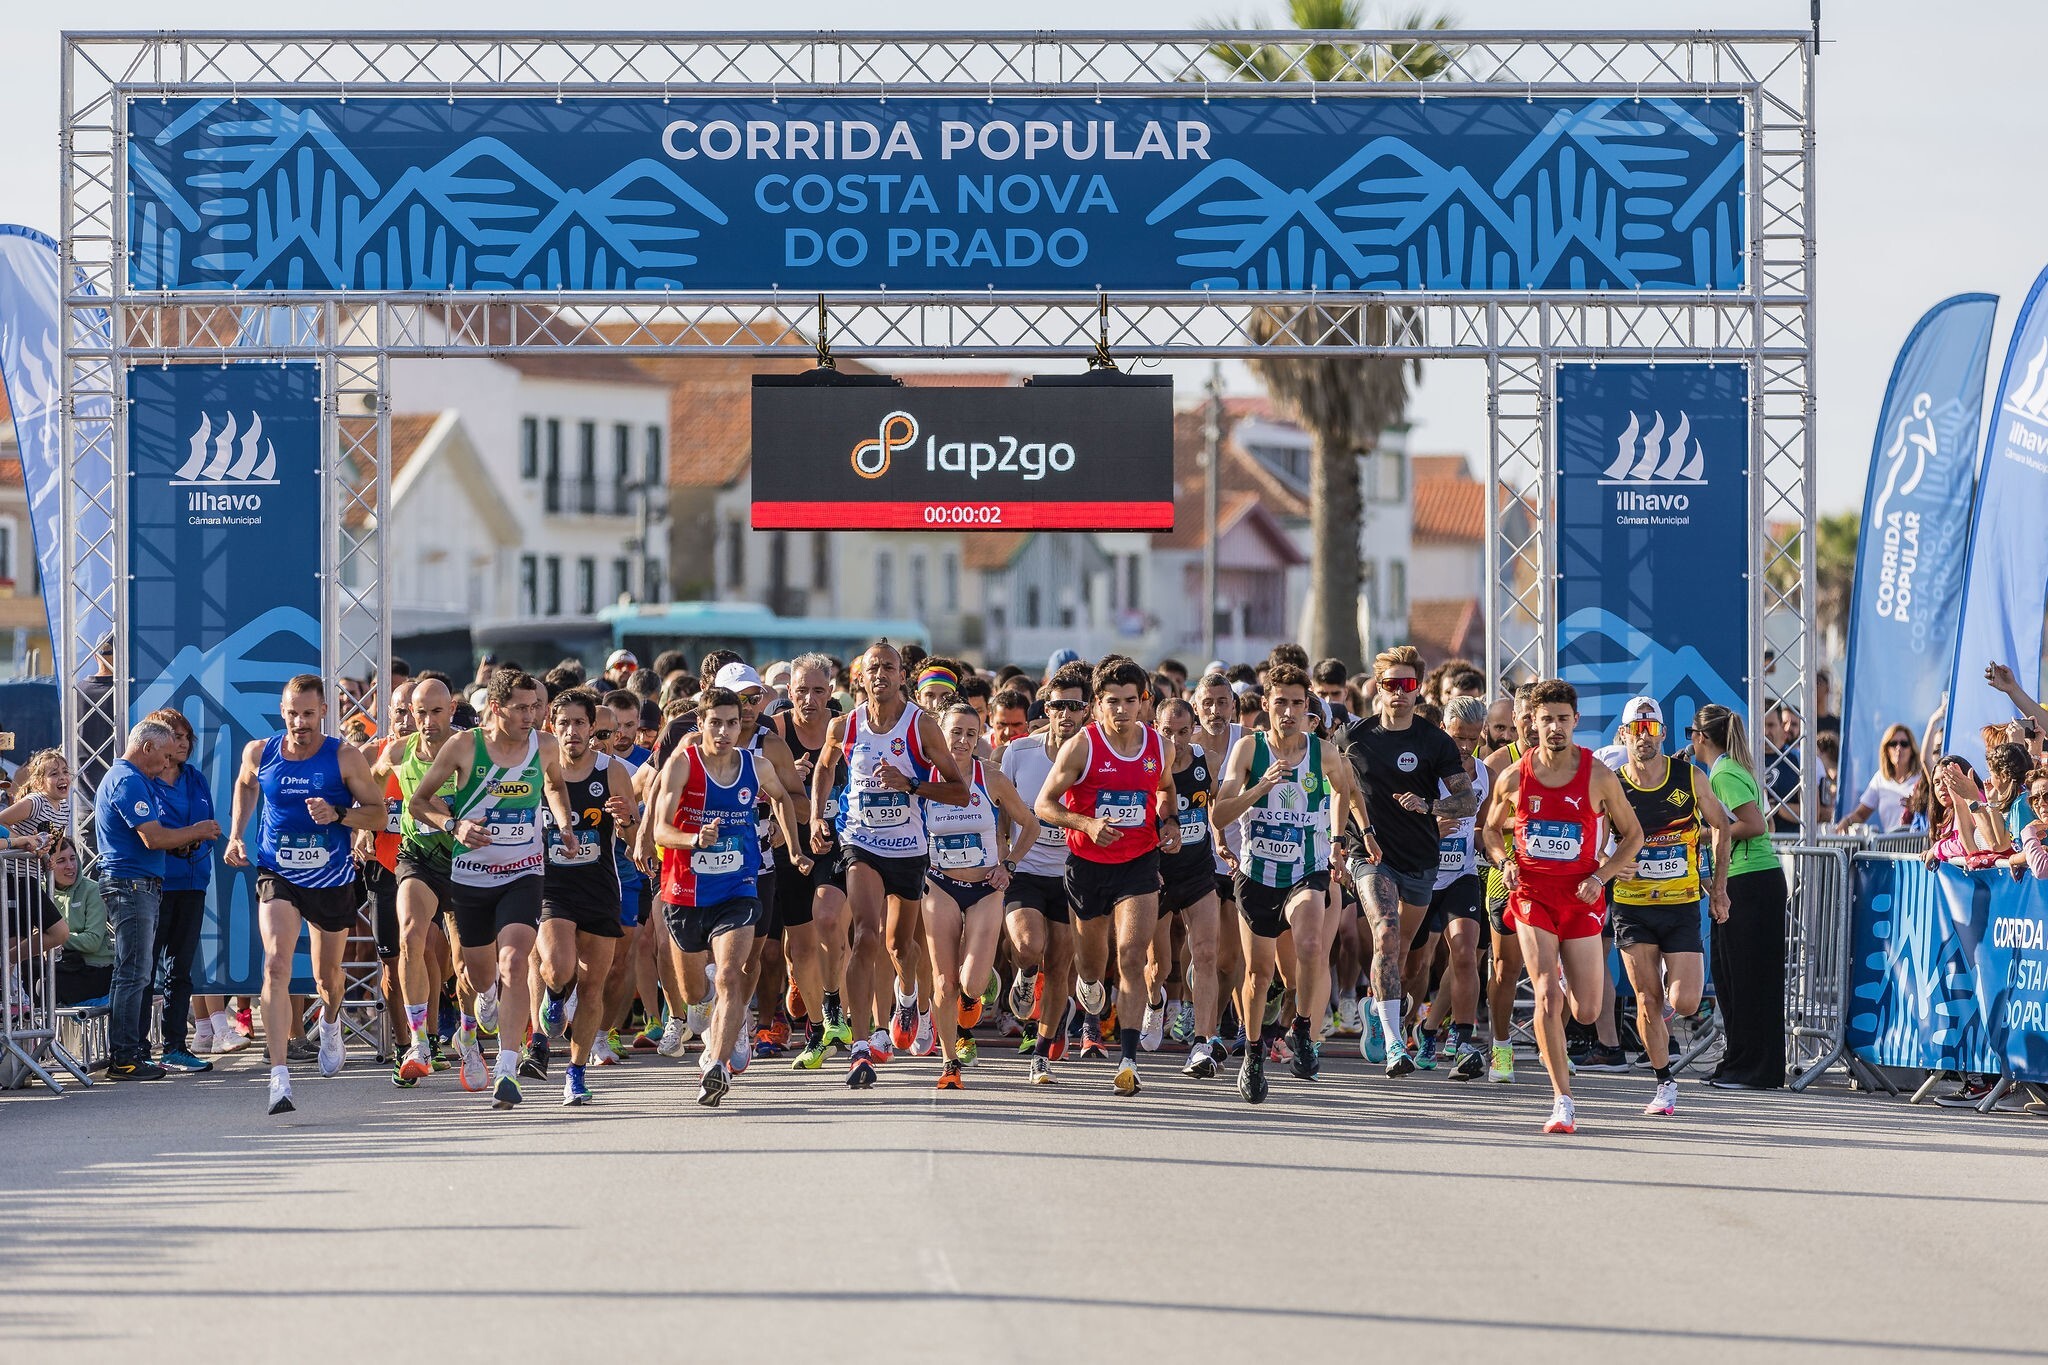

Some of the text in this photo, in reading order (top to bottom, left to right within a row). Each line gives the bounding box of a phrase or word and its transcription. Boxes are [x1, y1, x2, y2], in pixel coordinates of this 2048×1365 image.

[662, 121, 1211, 160] CORRIDA POPULAR
[754, 174, 1119, 214] COSTA NOVA
[785, 228, 1088, 267] DO PRADO
[927, 434, 1076, 480] lap2go
[924, 506, 1001, 523] 00:00:02
[188, 516, 262, 526] Câmara Municipal
[1616, 516, 1690, 526] Câmara Municipal
[1876, 510, 1903, 618] CORRIDA
[1894, 511, 1921, 623] POPULAR
[1910, 509, 1940, 655] COSTA NOVA
[499, 784, 530, 794] NAPO
[866, 808, 902, 819] A 930
[1103, 808, 1138, 818] A 927
[390, 816, 398, 825] A
[491, 826, 524, 836] D 28
[869, 835, 918, 848] ÁGUEDA
[1256, 840, 1265, 850] A
[1269, 842, 1296, 854] 1007
[1532, 838, 1571, 851] A 960
[298, 850, 319, 861] 204
[698, 854, 734, 865] A 129
[943, 851, 967, 861] A 1
[1642, 861, 1678, 872] A 186
[928, 868, 944, 880] FILA
[952, 880, 973, 888] FILA
